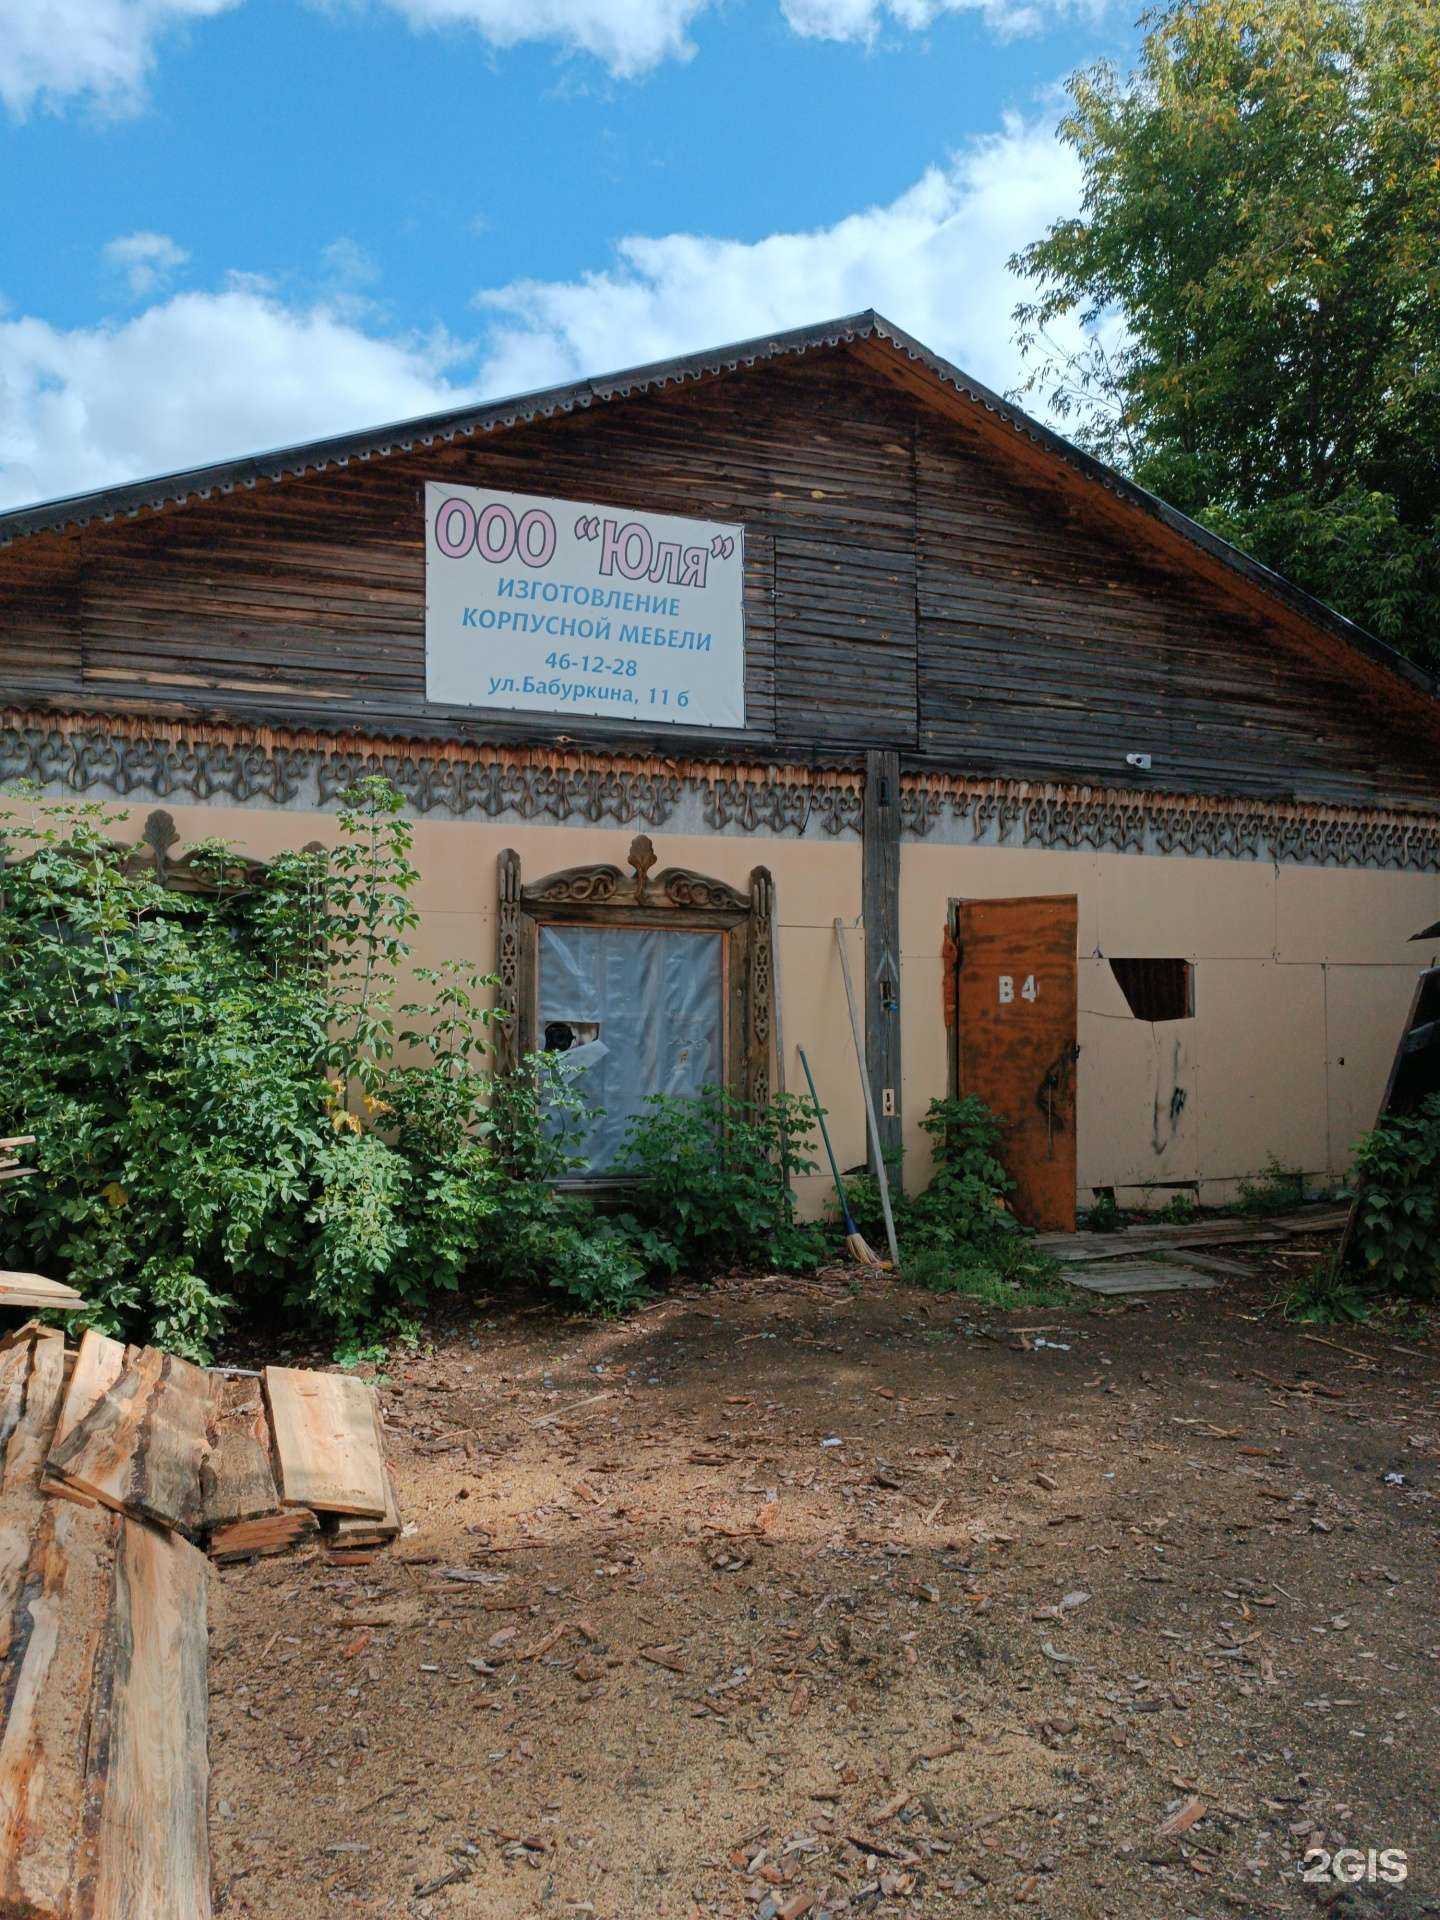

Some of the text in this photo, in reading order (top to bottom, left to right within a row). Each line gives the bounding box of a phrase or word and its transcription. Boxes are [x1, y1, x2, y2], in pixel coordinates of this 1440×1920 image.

[435, 497, 556, 568] ООО
[496, 577, 681, 616] ИЗГОТОВЛЕНИЕ
[462, 607, 712, 652] КОРПУСНОЙ МЕБЕЛИ
[545, 652, 638, 677] 46-12-28
[648, 687, 669, 706] 11
